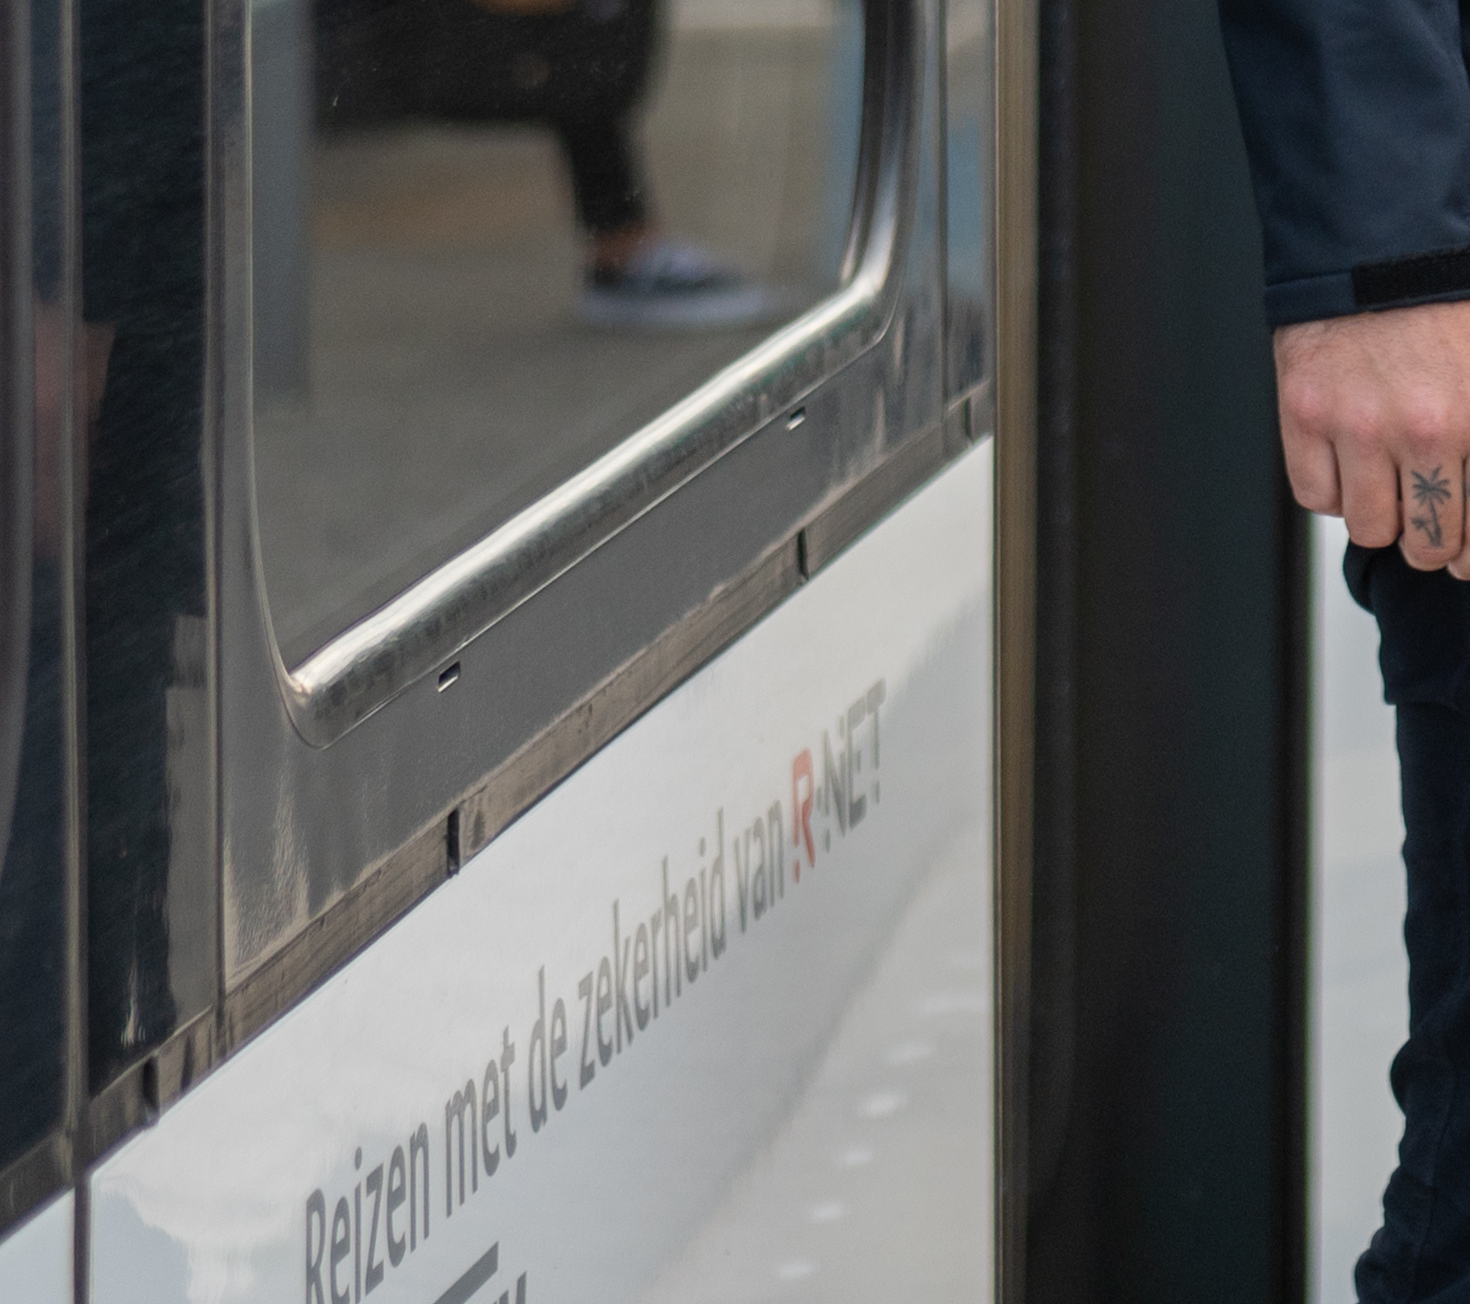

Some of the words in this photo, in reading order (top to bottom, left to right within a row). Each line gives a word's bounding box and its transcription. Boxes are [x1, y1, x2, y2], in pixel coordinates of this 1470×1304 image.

[305, 1123, 430, 1304] Reizen
[445, 1025, 518, 1219] met
[529, 965, 568, 1134] de
[578, 806, 727, 1091] zekerheid
[734, 799, 784, 935] van
